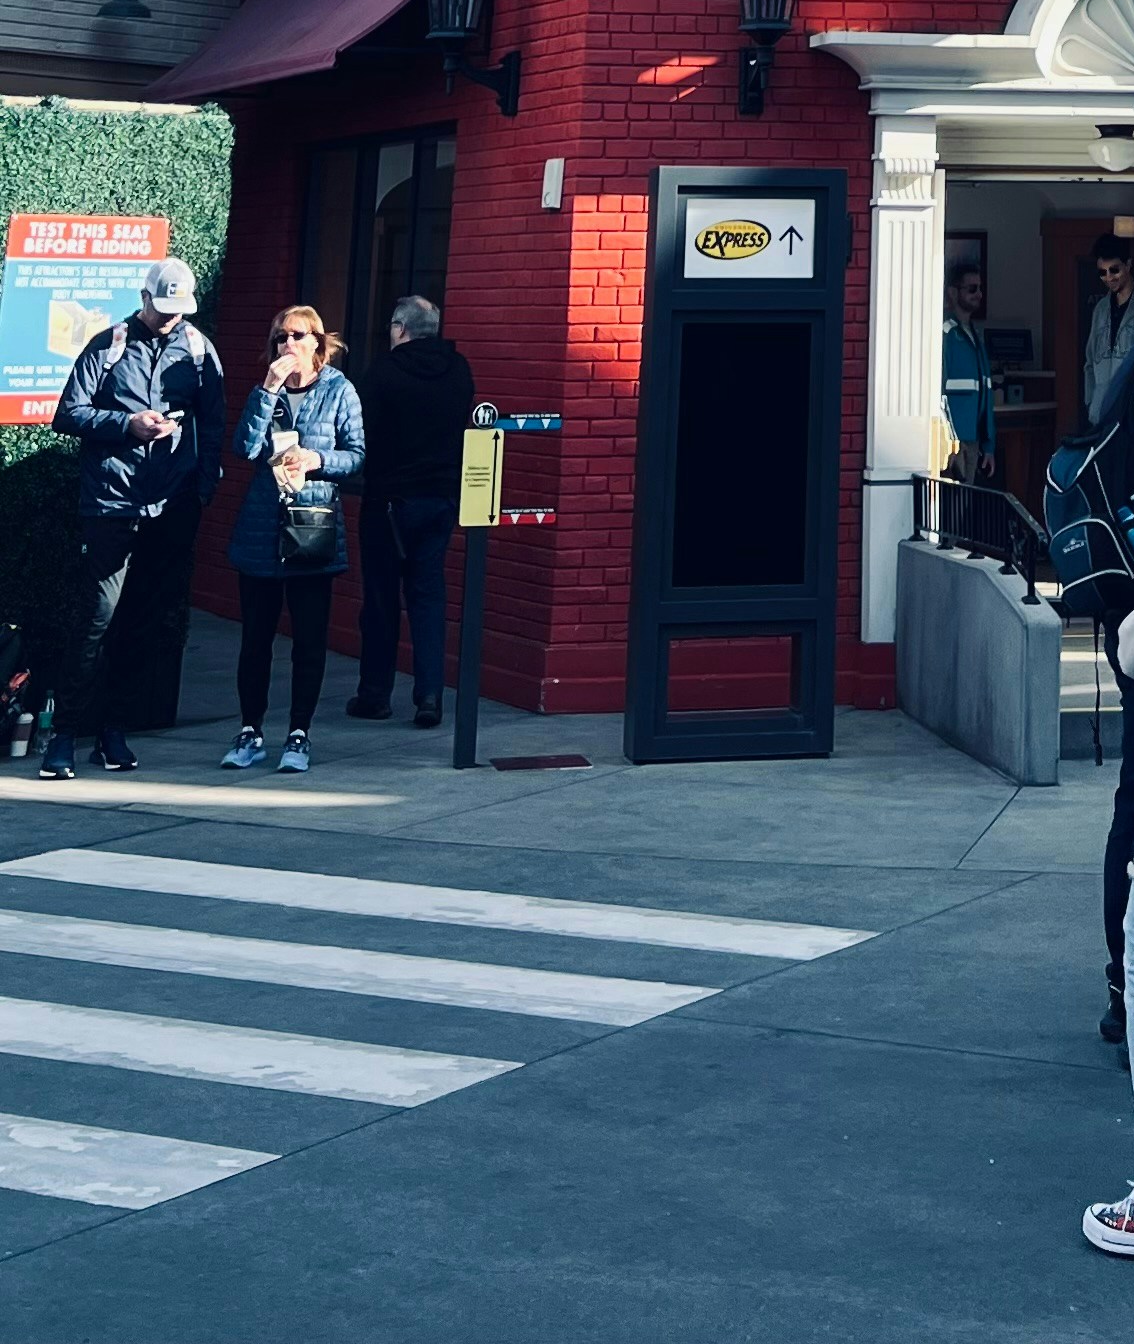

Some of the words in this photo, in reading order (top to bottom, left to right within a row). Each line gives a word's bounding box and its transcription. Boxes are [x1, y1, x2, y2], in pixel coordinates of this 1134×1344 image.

[29, 221, 67, 237] TEST
[71, 222, 107, 239] THIS
[112, 223, 151, 240] SEAT
[24, 237, 87, 254] BEFORE
[91, 238, 152, 255] RIDING
[702, 230, 766, 257] EXPRESS
[3, 365, 35, 375] PLEASE
[8, 378, 35, 388] YOUR
